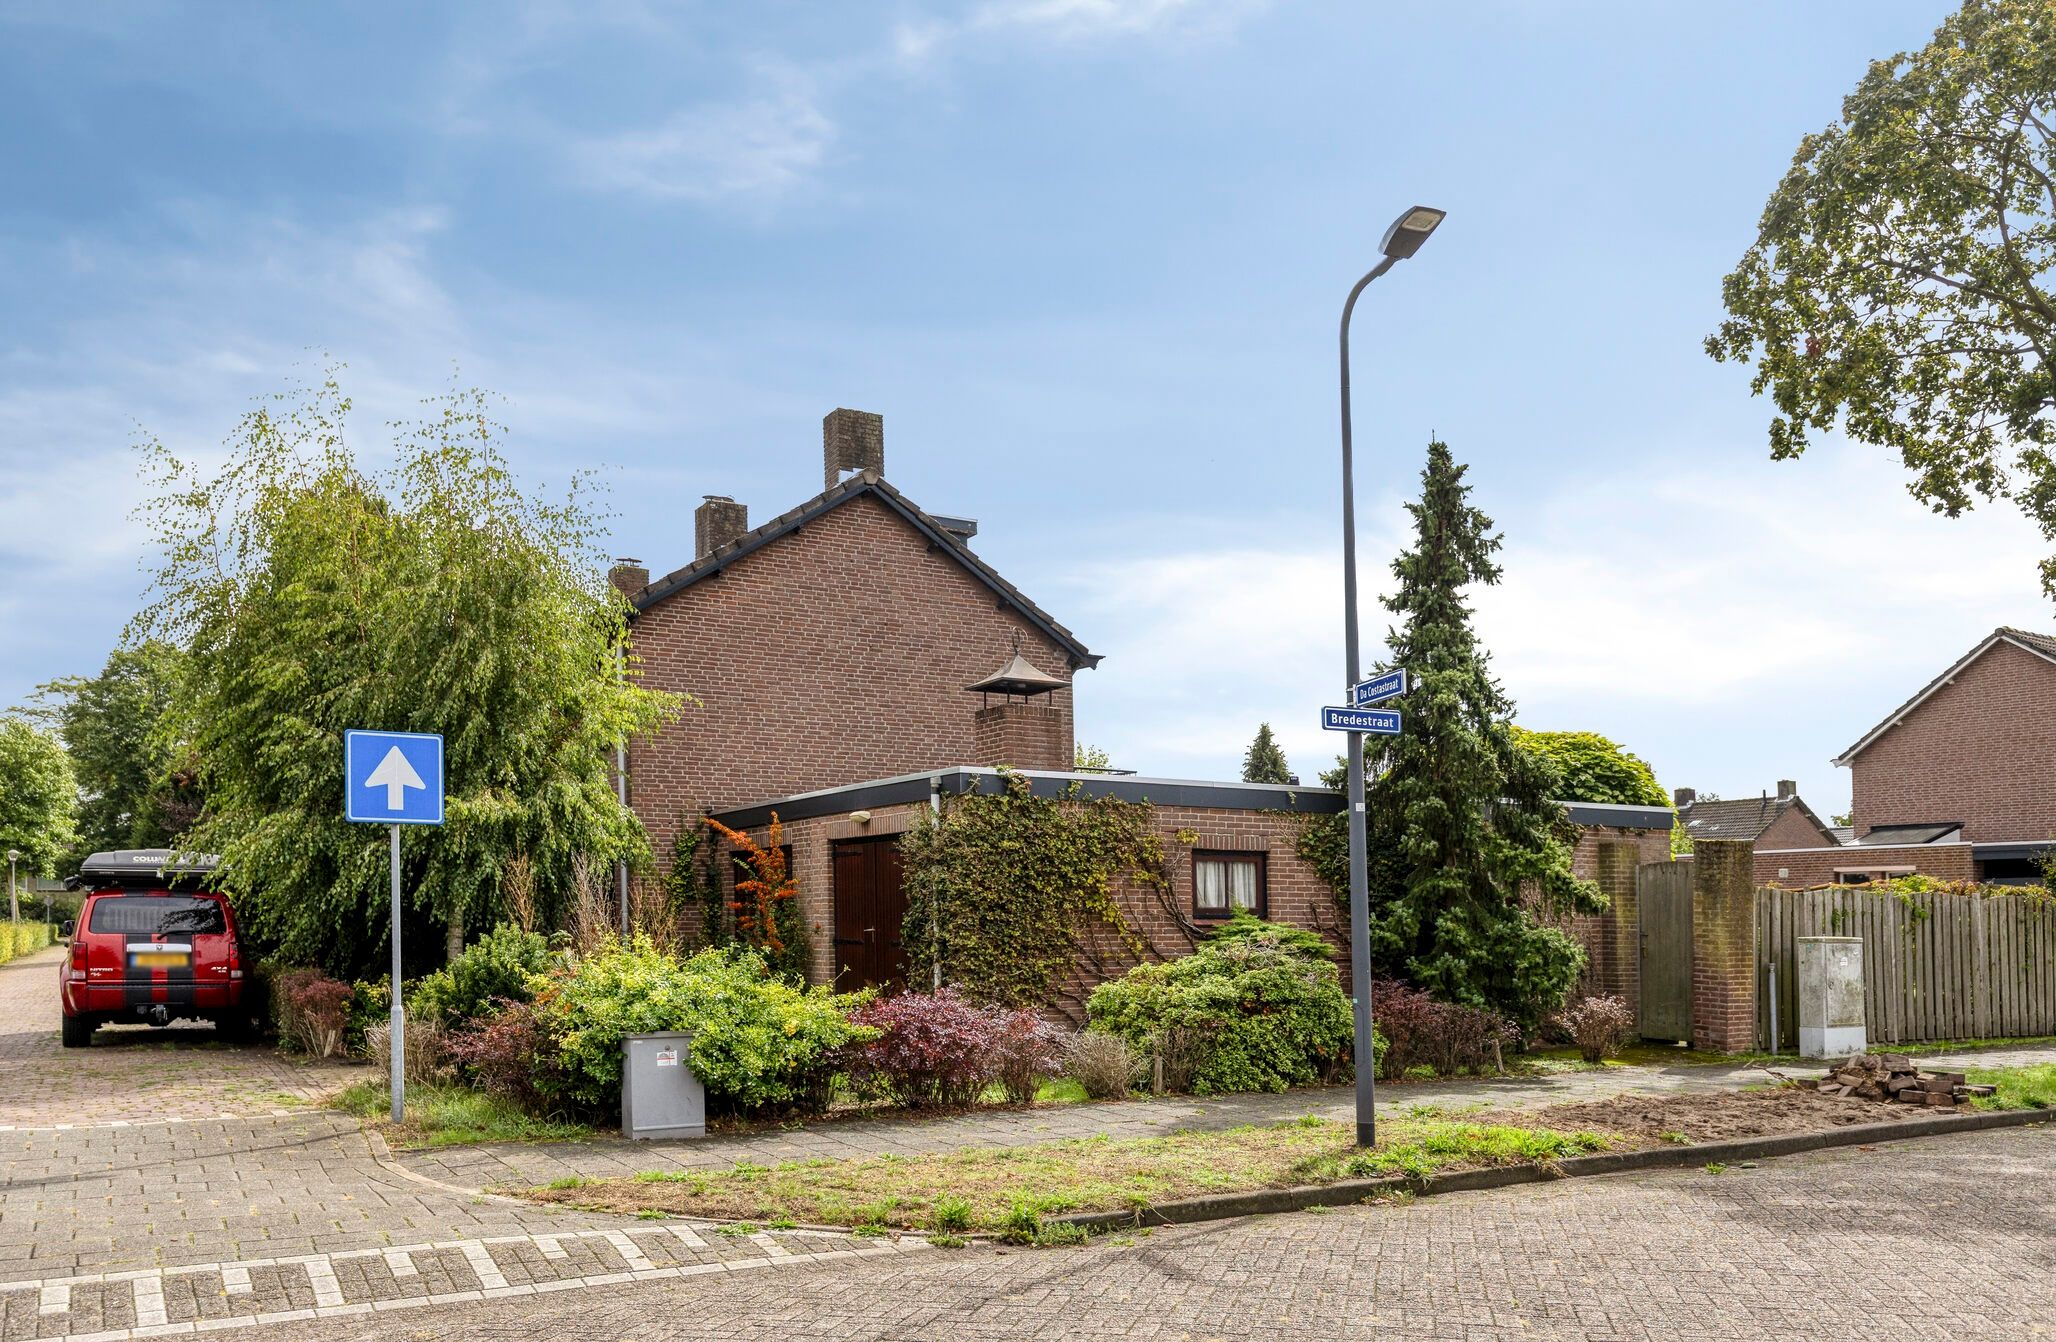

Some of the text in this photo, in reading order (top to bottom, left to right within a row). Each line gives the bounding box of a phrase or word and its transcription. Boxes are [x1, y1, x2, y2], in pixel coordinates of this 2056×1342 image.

[1360, 679, 1398, 699] Da Costastraat
[1331, 713, 1394, 727] Bredestraat
